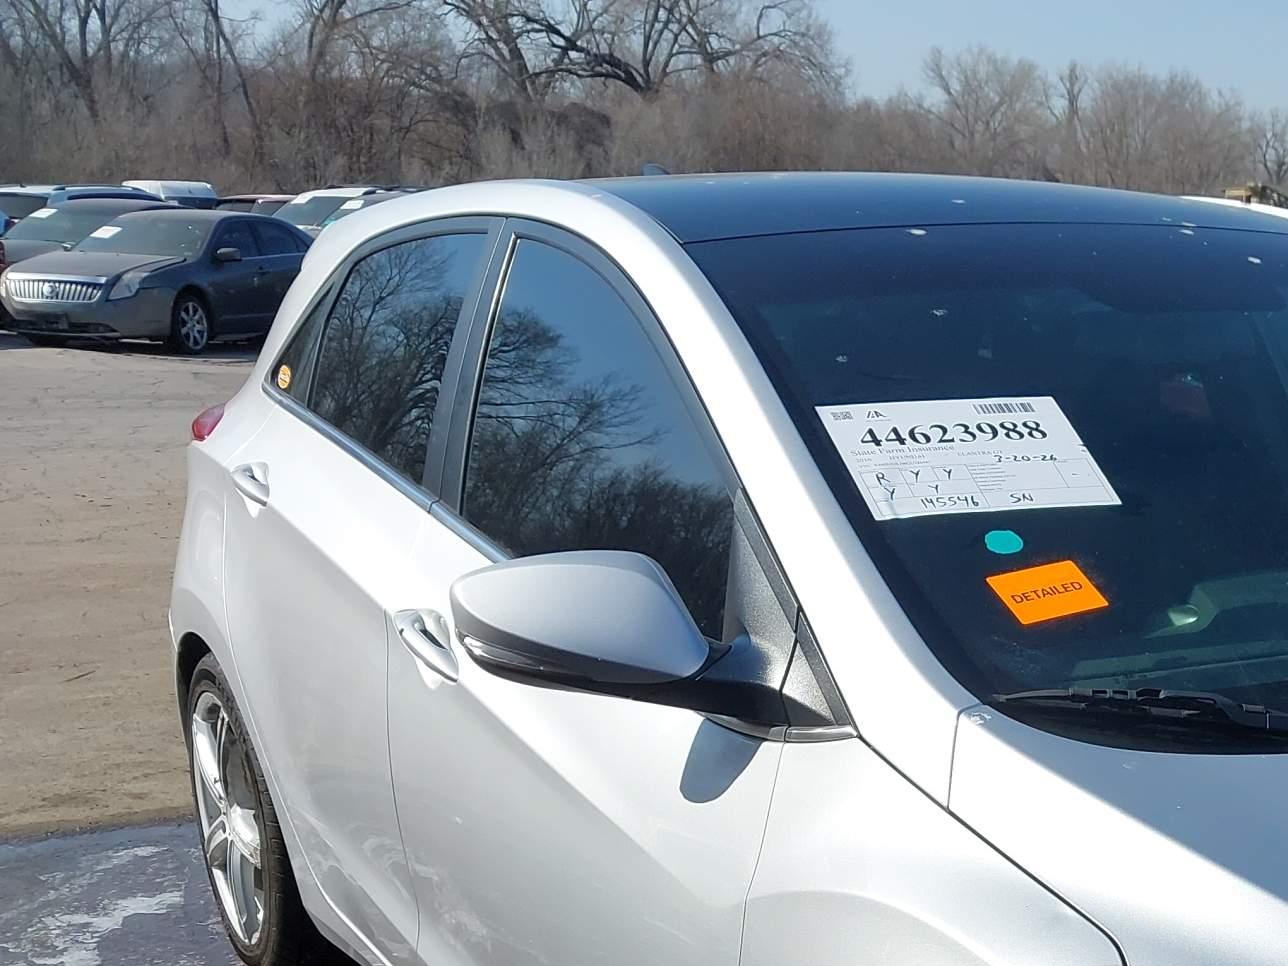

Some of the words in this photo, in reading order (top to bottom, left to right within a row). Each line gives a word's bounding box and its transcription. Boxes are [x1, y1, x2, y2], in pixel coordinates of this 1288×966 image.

[860, 420, 1048, 447] 44623988
[910, 469, 921, 483] Y
[942, 468, 953, 481] Y
[883, 487, 896, 501] Y
[927, 484, 939, 494] Y
[1009, 493, 1034, 503] SN
[1010, 581, 1083, 604] DETAILED
